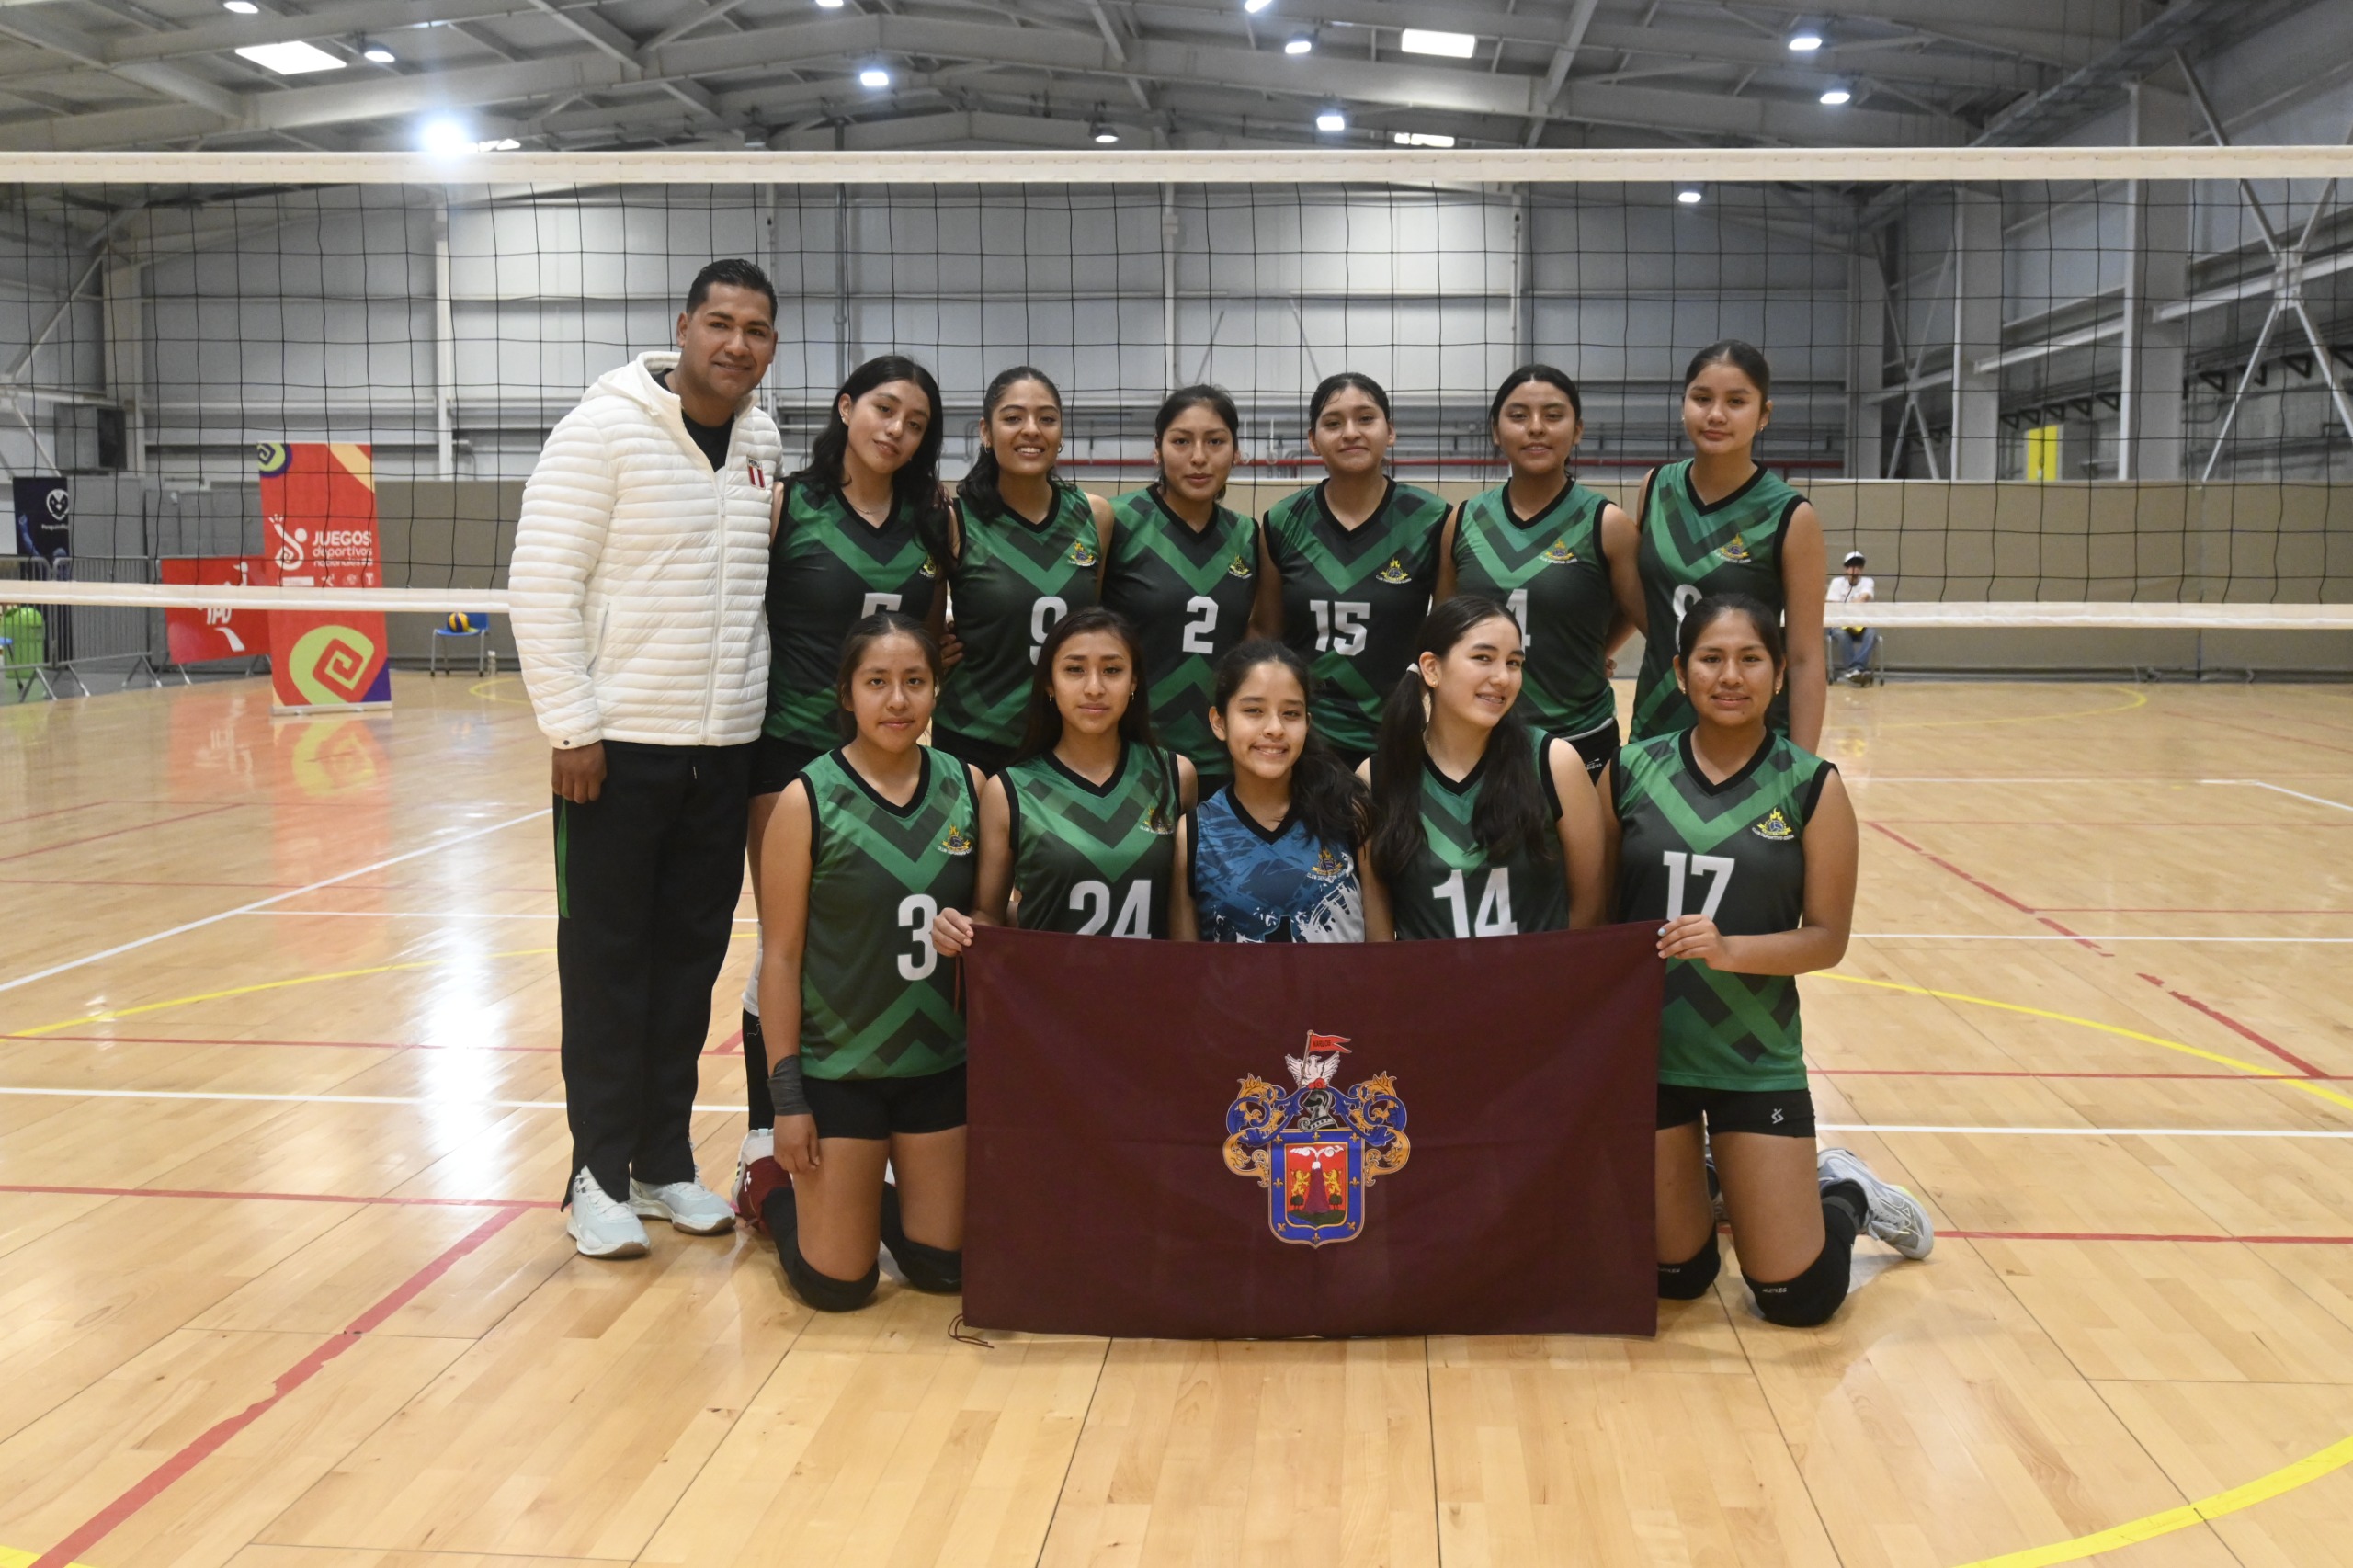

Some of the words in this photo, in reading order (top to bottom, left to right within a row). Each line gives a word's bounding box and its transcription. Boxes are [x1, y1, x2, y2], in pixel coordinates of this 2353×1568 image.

[313, 530, 372, 547] JUEGOS
[313, 545, 373, 560] deportivos
[1182, 595, 1219, 654] 2
[1310, 599, 1370, 656] 15
[1069, 880, 1152, 939] 24
[1432, 867, 1518, 938] 14
[1663, 850, 1735, 922] 17
[897, 893, 938, 981] 3
